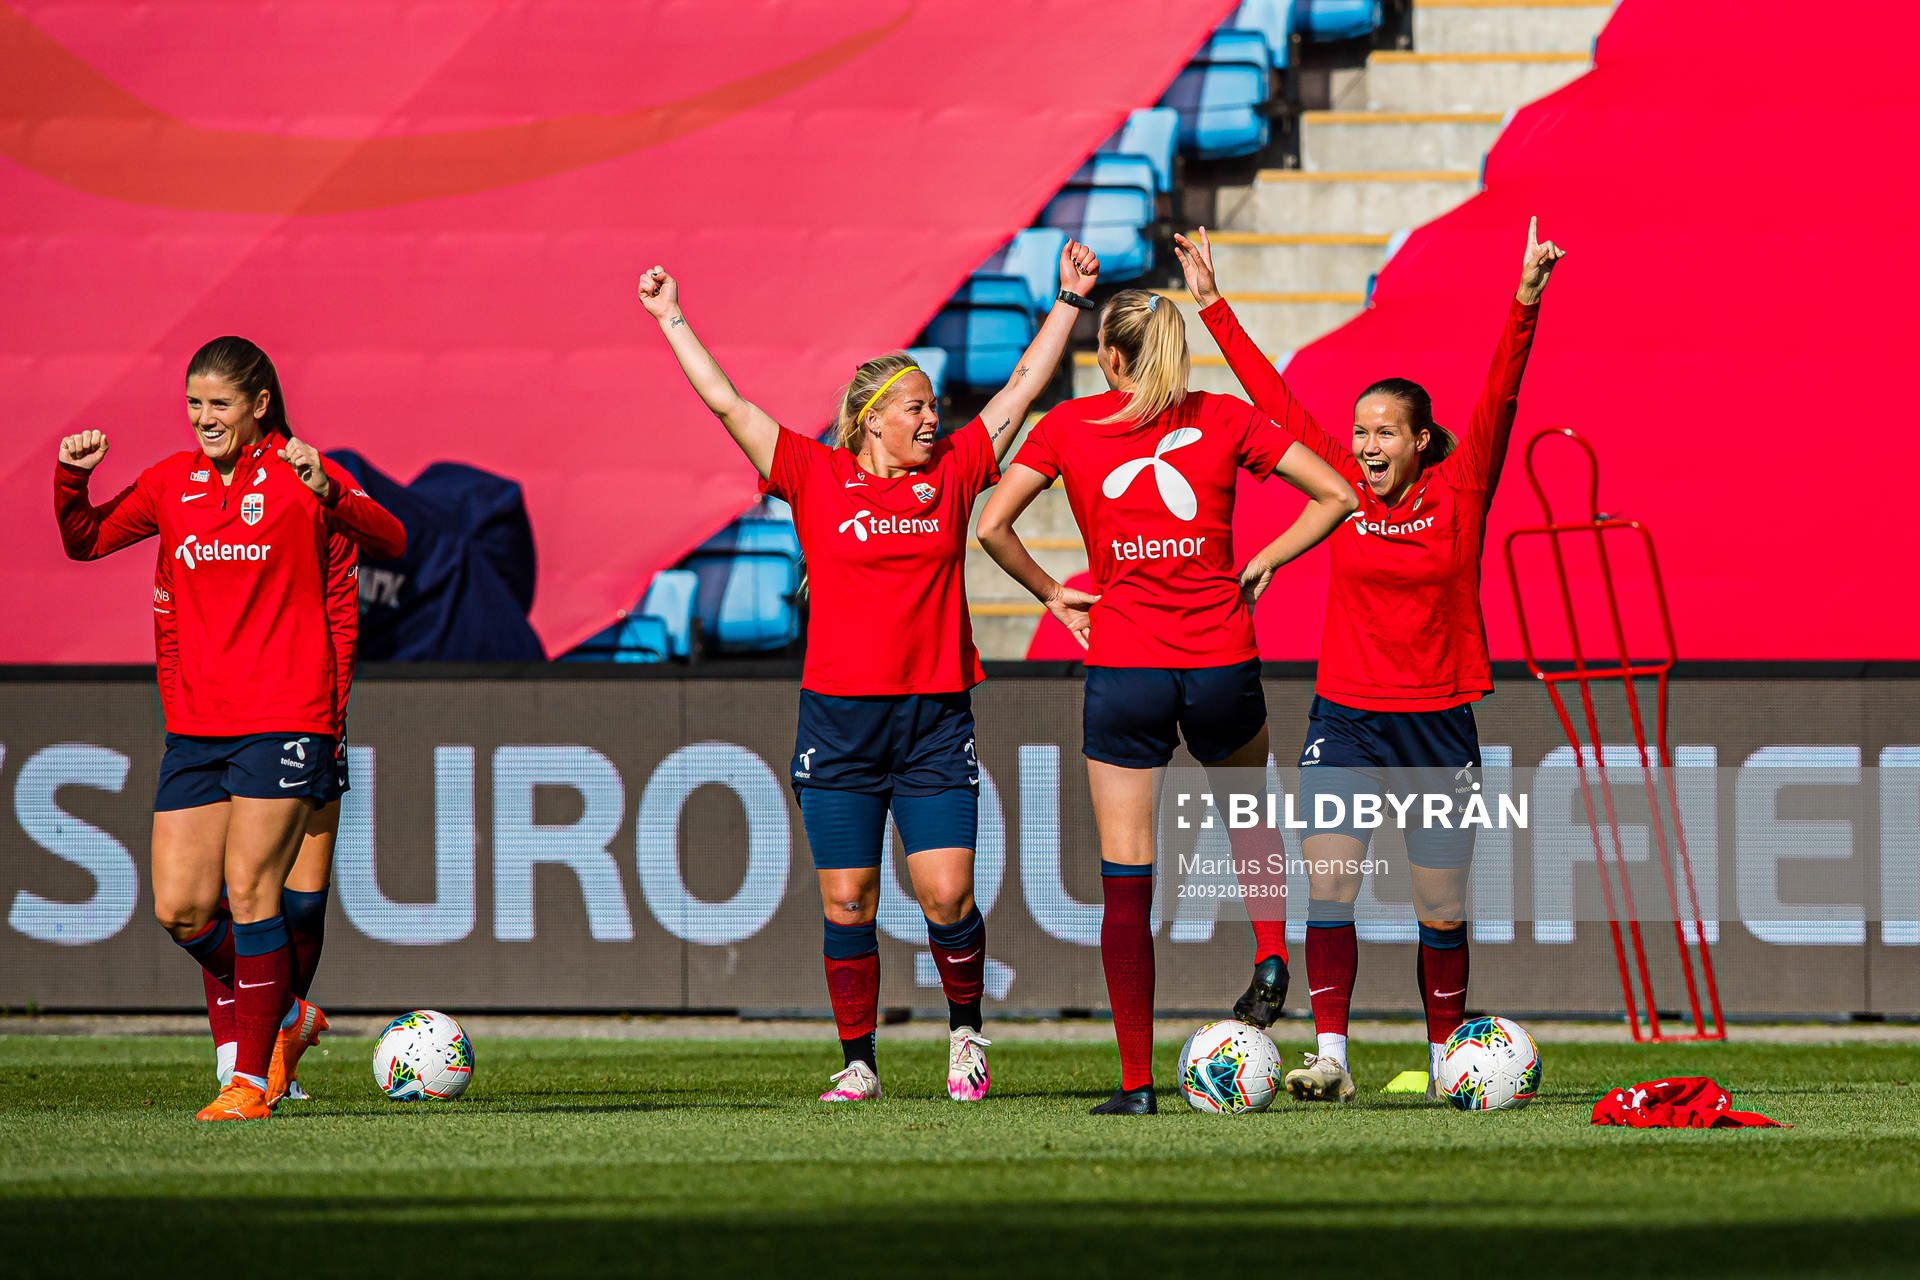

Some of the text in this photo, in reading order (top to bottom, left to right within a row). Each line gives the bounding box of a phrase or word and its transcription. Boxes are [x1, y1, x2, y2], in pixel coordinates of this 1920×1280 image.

[868, 515, 940, 535] telenor
[1360, 516, 1435, 536] telenor
[194, 539, 272, 561] telenor
[1111, 535, 1206, 561] telenor
[152, 585, 170, 602] NB
[334, 740, 793, 946] URO
